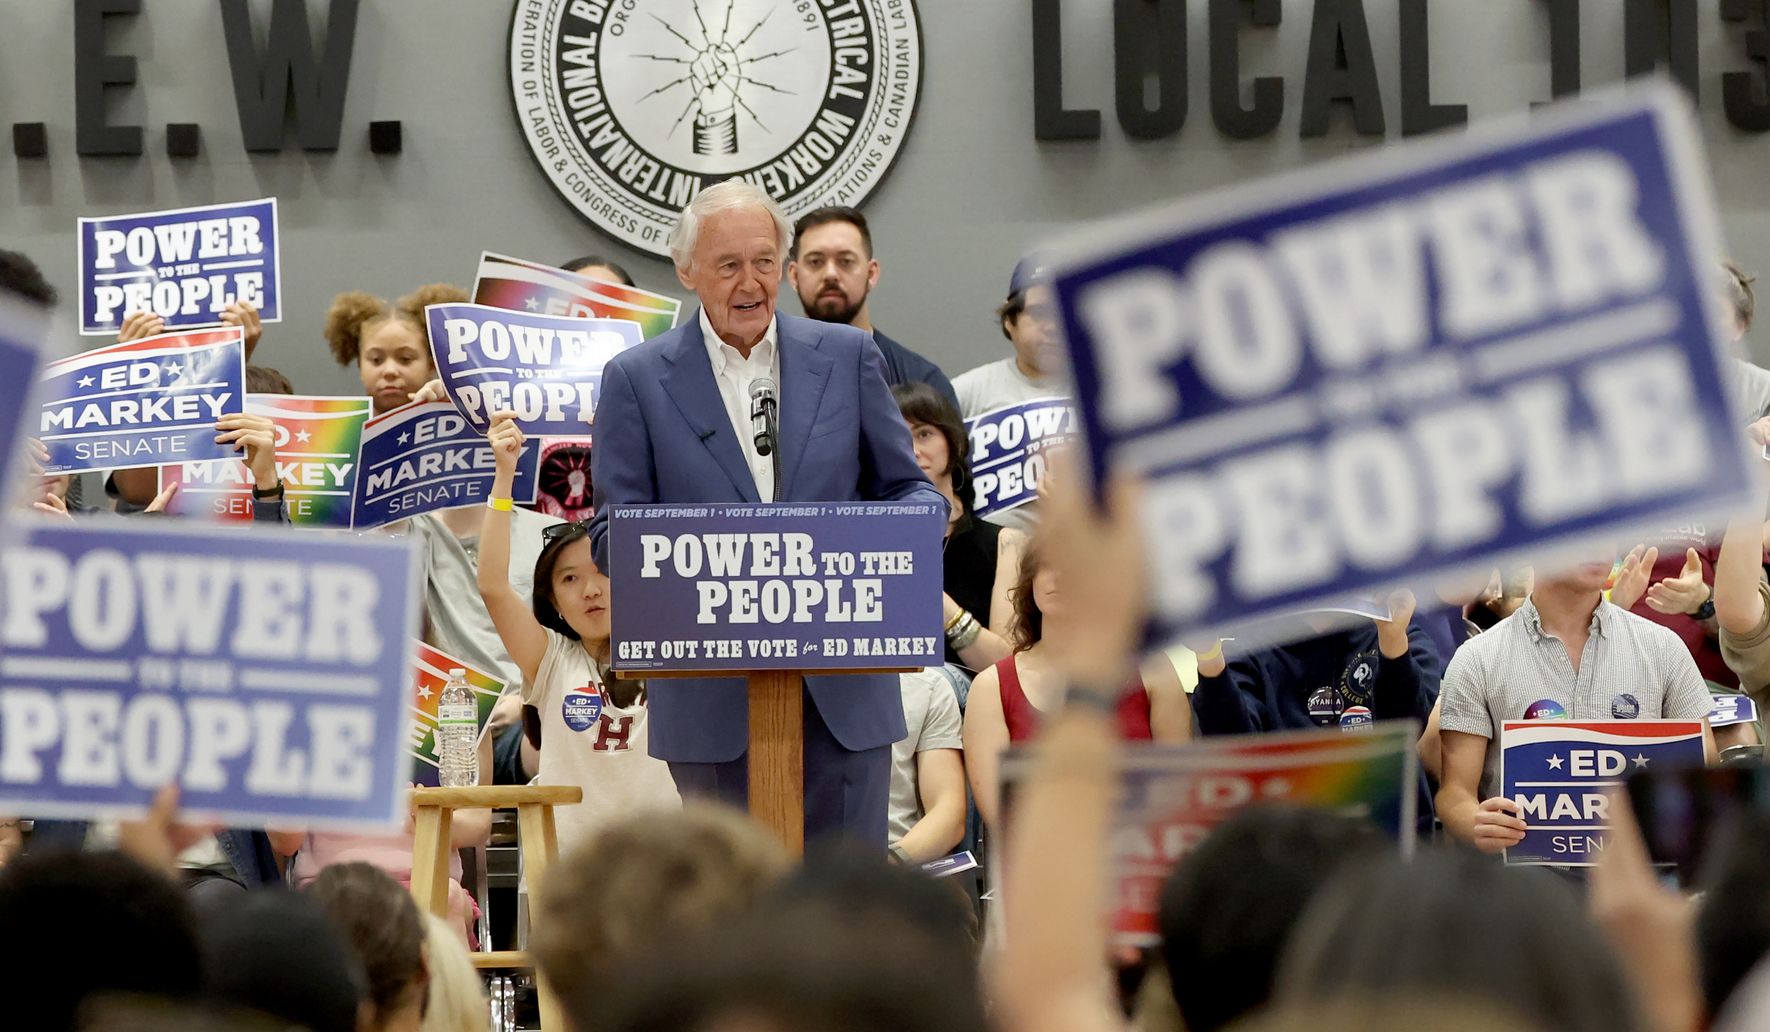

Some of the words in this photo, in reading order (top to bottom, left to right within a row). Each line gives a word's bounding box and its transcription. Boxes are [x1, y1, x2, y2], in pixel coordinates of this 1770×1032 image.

[823, 0, 868, 99] TRICAL
[1033, 0, 1468, 141] LOCAL
[522, 80, 539, 100] OF
[877, 134, 892, 146] &
[885, 38, 910, 129] CANADIAN
[528, 107, 559, 161] LABOR
[562, 31, 702, 208] INTERNATIONAL
[554, 159, 568, 174] &
[565, 172, 638, 234] CONGRESS
[94, 215, 263, 269] POWER
[641, 225, 662, 243] OF
[158, 266, 175, 278] TO
[175, 264, 200, 277] THE
[94, 271, 264, 322] PEOPLE
[1076, 148, 1670, 433] POWER
[101, 361, 160, 390] ED
[516, 367, 533, 379] TO
[40, 392, 232, 432] MARKEY
[455, 380, 598, 424] PEOPL
[75, 434, 187, 460] SENATE
[414, 415, 465, 445] ED
[1026, 443, 1041, 455] TO
[1041, 436, 1065, 451] THE
[182, 461, 353, 487] MAKEY
[973, 454, 1046, 511] PEO
[1140, 343, 1712, 622] PEOPLE
[388, 481, 482, 514] SENATE
[614, 508, 643, 518] VOTE
[644, 508, 708, 518] SEPTEMBER
[709, 508, 715, 518] 1
[725, 507, 755, 517] VOTE
[755, 507, 818, 517] SEPTEMBER
[820, 507, 826, 516] 1
[836, 506, 864, 516] VOTE
[866, 505, 929, 516] SEPTEMBER
[931, 505, 937, 515] 1
[640, 533, 816, 578] POWER
[821, 551, 856, 576] TO
[860, 551, 913, 575] THE
[0, 547, 384, 665] POWER
[696, 578, 883, 625] PEOPLE
[618, 641, 656, 659] GET
[660, 640, 698, 659] OUT
[703, 640, 742, 658] THE
[747, 639, 797, 658] VOTE
[802, 641, 818, 655] for
[823, 638, 848, 657] ED
[853, 637, 937, 656] MARKEY
[565, 708, 598, 716] MARKEY
[576, 697, 587, 705] ED
[0, 687, 377, 799] PEOPLE
[593, 714, 635, 752] H
[1570, 750, 1627, 777] ED
[1515, 793, 1611, 820] MAR
[1552, 836, 1603, 853] SEN
